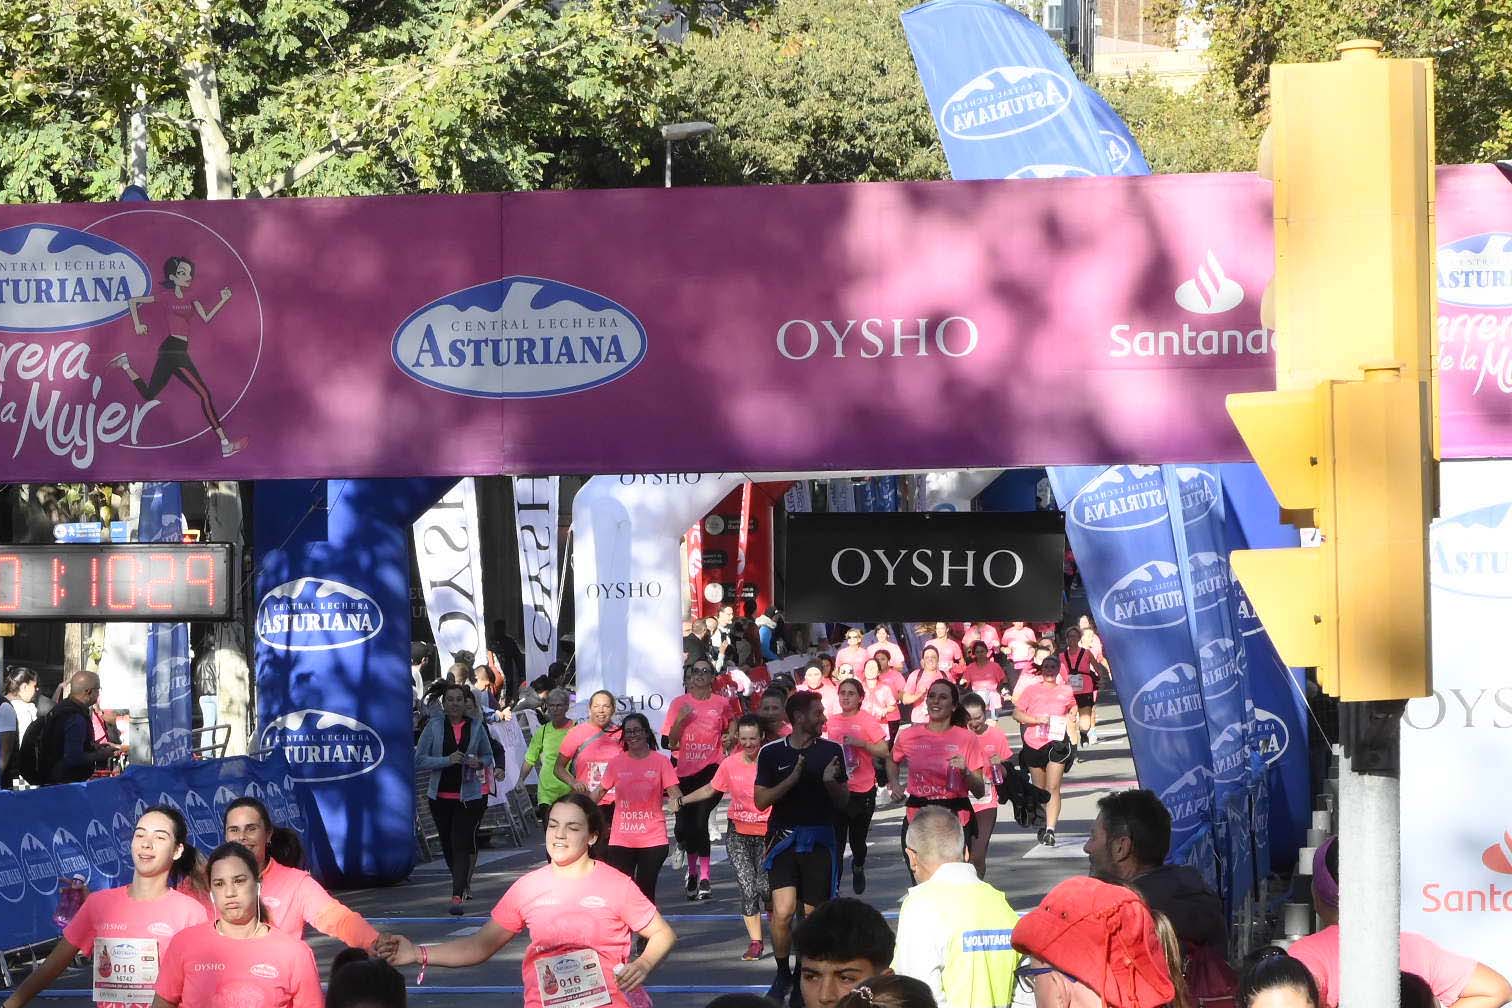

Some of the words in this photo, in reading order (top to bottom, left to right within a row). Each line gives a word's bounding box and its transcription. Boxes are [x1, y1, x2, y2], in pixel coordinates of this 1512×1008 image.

[54, 259, 127, 272] LECHERA
[450, 319, 530, 332] CENTRAL
[537, 316, 620, 330] LECHERA
[411, 321, 628, 369] ASTURIANA
[775, 315, 978, 360] OYSHO
[12, 375, 162, 470] Mujer
[619, 472, 702, 486] OYSHO
[830, 547, 1024, 588] OYSHO
[585, 581, 663, 600] OYSHO
[273, 601, 316, 611] CENTRAL
[320, 601, 370, 611] LECHERA
[260, 607, 374, 635] ASTURIANA
[617, 693, 665, 712] SHO
[283, 743, 374, 763] TURIANA
[619, 822, 647, 831] SUMA
[963, 934, 1012, 947] VOLUNTARI
[113, 964, 136, 974] 016
[559, 975, 582, 988] 016
